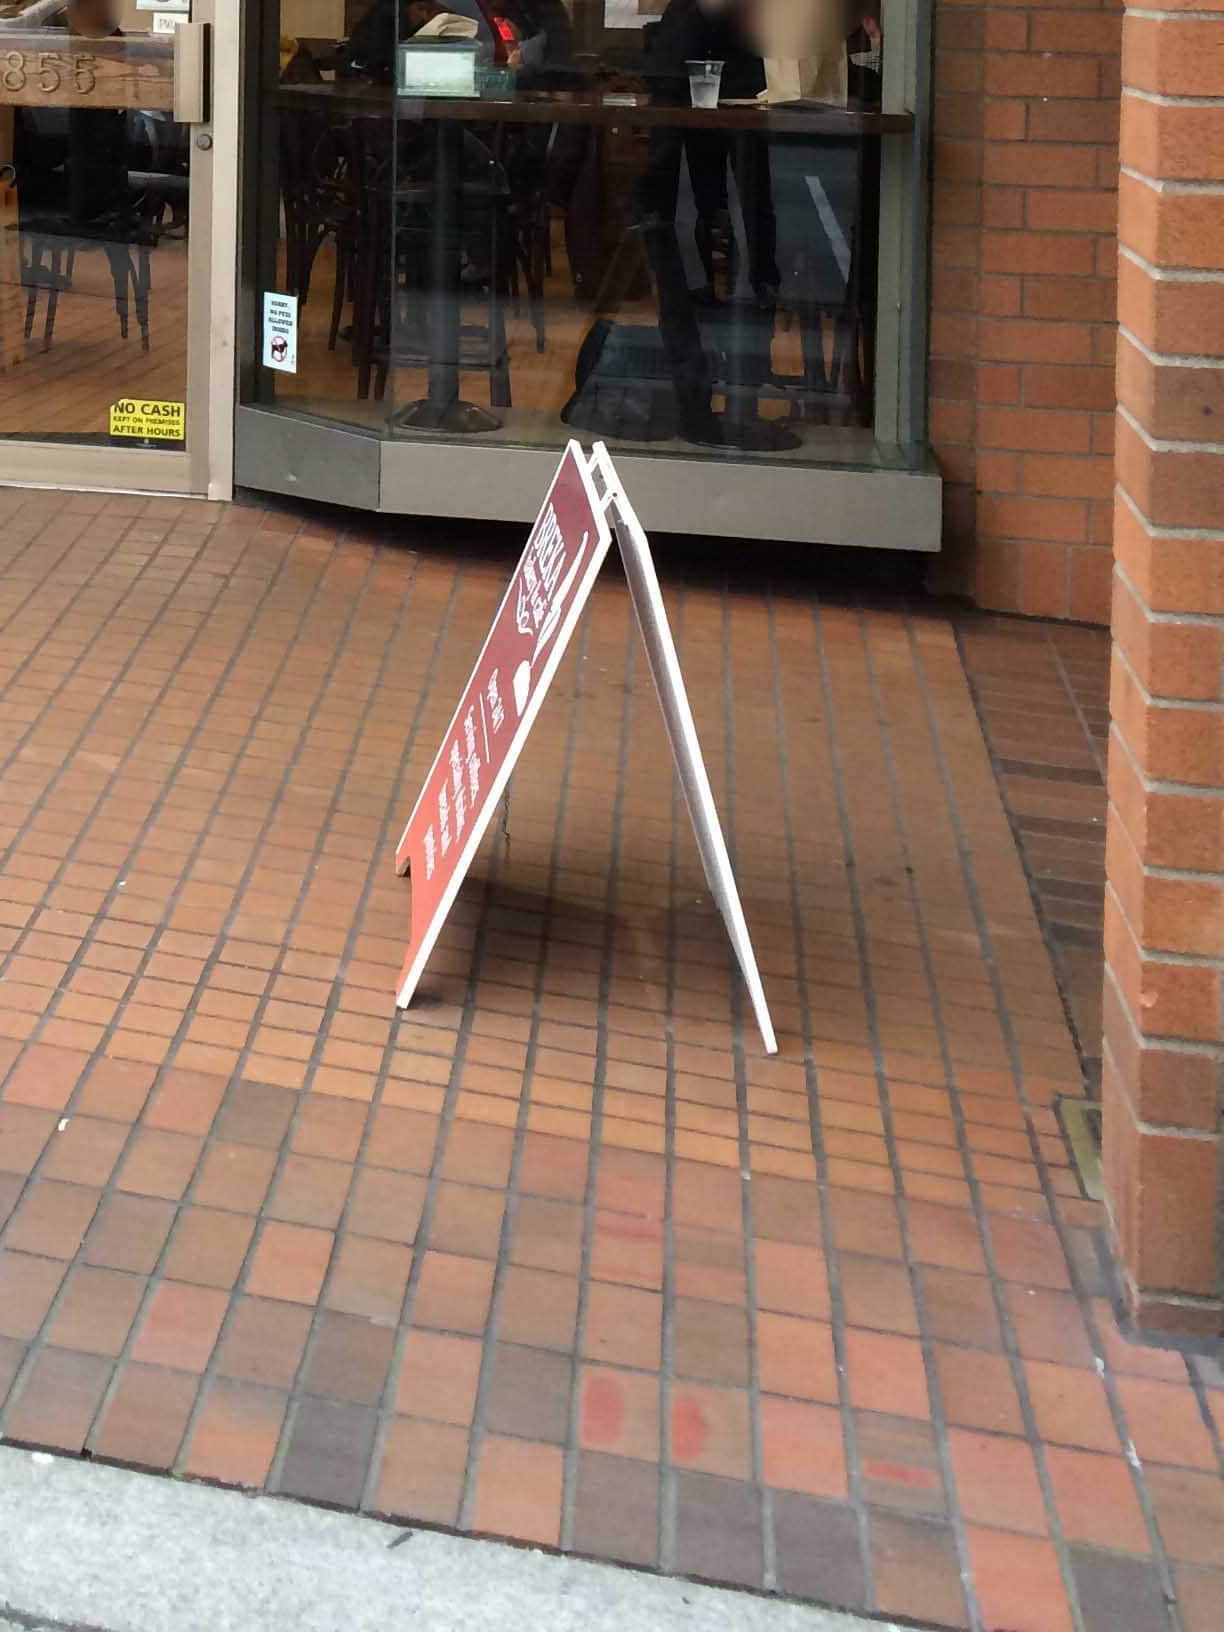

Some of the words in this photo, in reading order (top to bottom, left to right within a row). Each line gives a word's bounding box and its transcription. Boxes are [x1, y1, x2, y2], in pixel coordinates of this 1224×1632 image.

[2, 50, 96, 95] 855
[114, 402, 136, 414] NO
[141, 403, 181, 417] CASH
[113, 424, 143, 434] AFTER
[146, 427, 181, 437] HOURS
